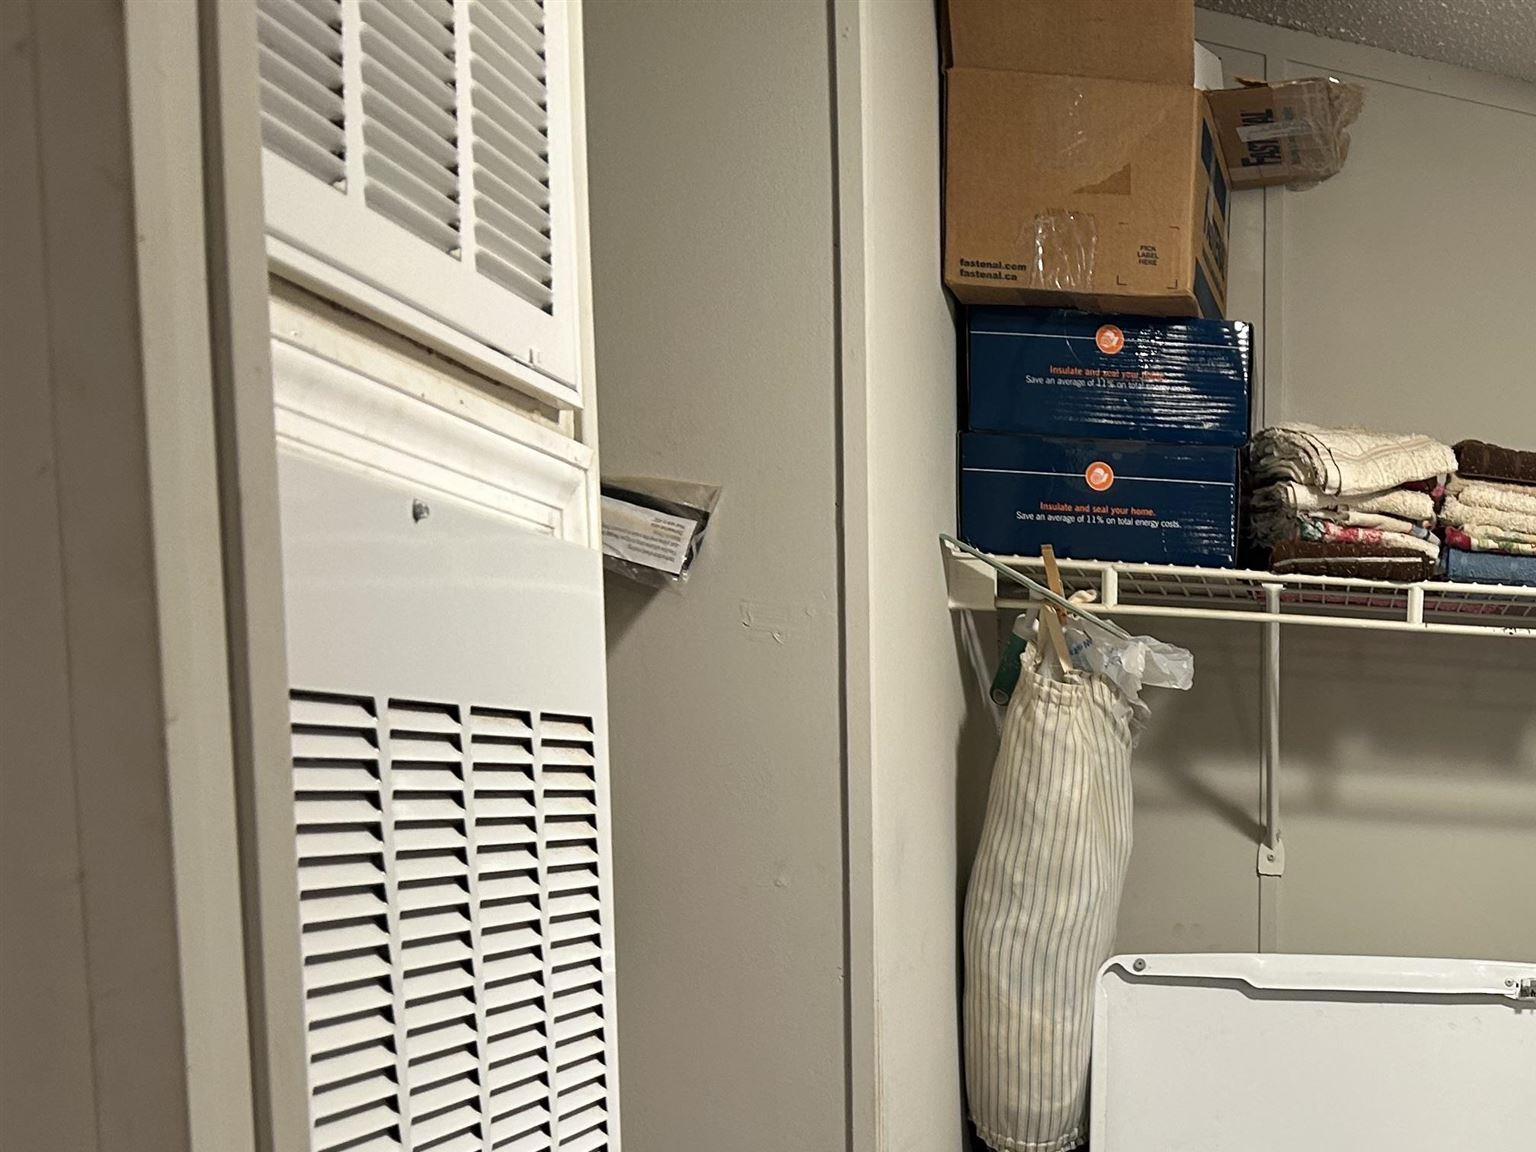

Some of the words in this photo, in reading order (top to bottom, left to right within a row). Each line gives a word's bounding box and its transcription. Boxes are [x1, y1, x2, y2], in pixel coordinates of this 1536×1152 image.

[1137, 251, 1159, 259] LABEL
[960, 258, 1027, 271] fastenal.com
[960, 269, 1018, 281] fastenal.ca
[1050, 367, 1082, 376] Insulate
[1025, 375, 1044, 384] Save
[1045, 377, 1056, 385] an
[1057, 378, 1085, 388] average
[1087, 378, 1095, 386] of
[1040, 501, 1072, 512] Insulate
[1074, 505, 1091, 513] and
[1092, 505, 1109, 514] seal
[1111, 507, 1129, 516] your
[1131, 506, 1156, 516] home.
[1016, 511, 1034, 521] Save
[1047, 514, 1076, 525] average
[1076, 514, 1085, 523] of
[1086, 515, 1104, 524] 11%
[1117, 517, 1134, 526] total
[1135, 518, 1159, 529] energy
[1160, 520, 1182, 529] costs.
